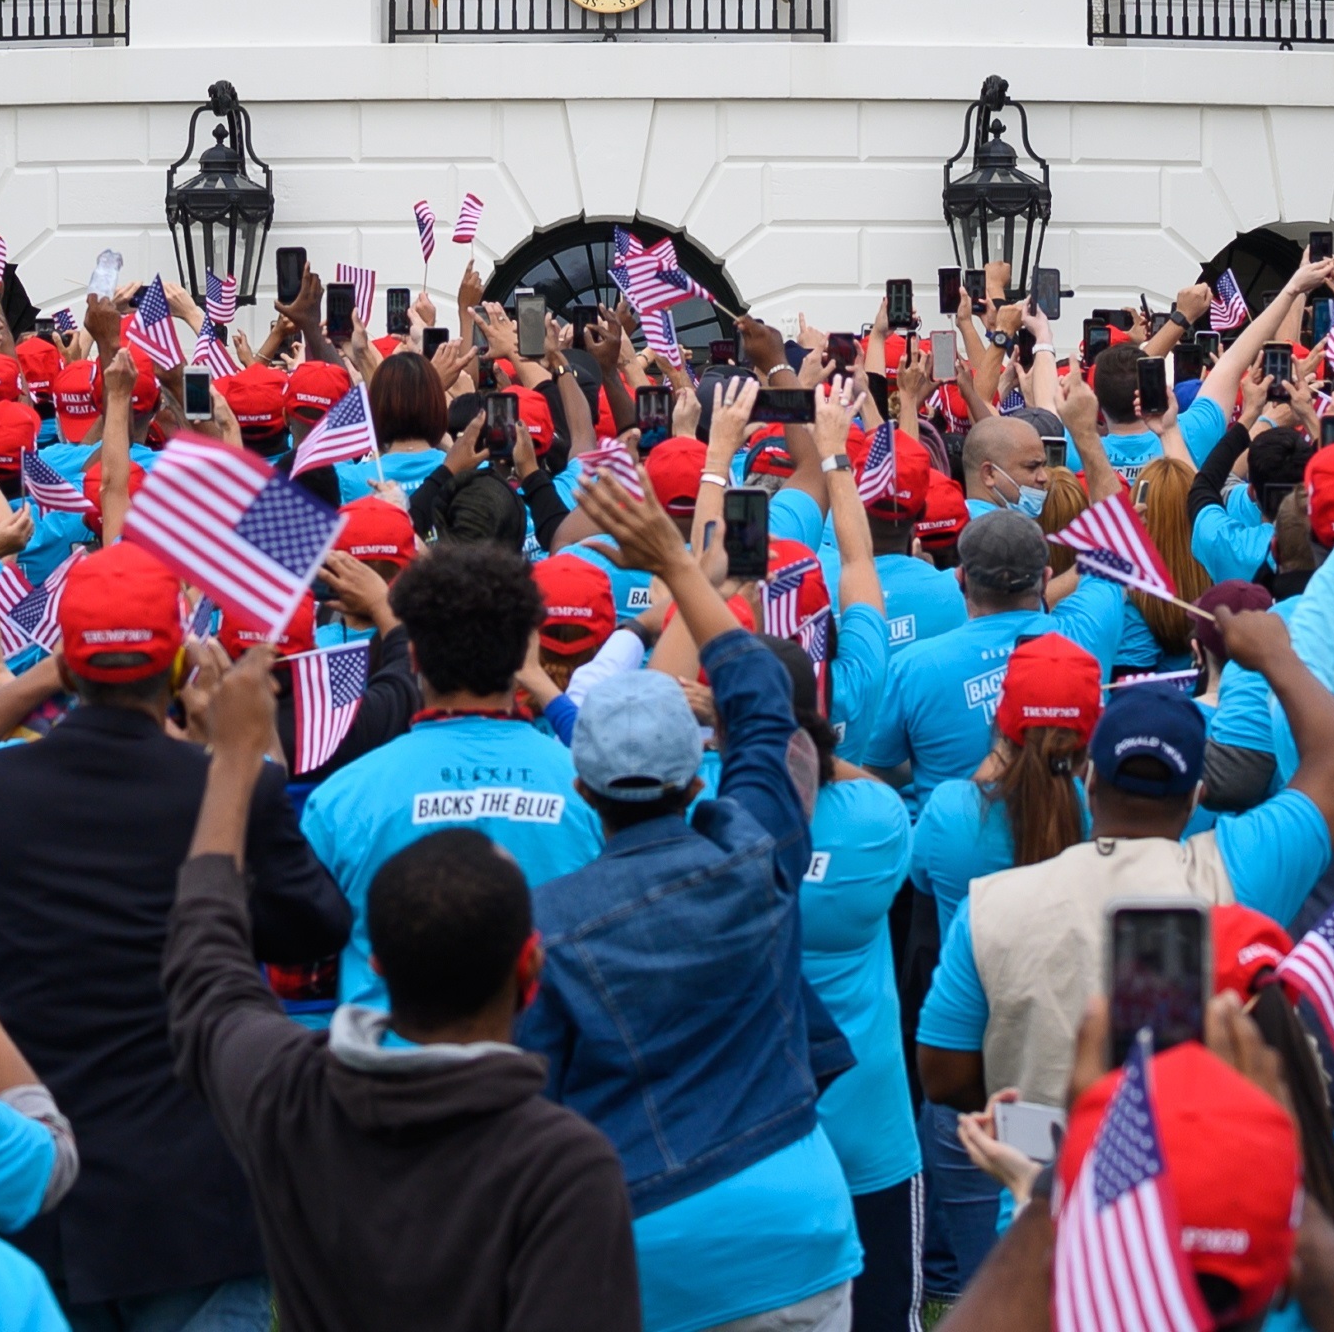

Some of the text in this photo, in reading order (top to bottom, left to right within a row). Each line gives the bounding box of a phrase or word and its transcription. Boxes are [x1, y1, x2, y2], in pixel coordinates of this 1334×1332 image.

[61, 393, 79, 403] MAKE
[296, 392, 331, 405] TRUMP2020
[66, 404, 89, 414] GREAT
[1022, 706, 1080, 718] TRUMP2020
[1114, 736, 1160, 756] DONALD
[417, 792, 560, 819] BACKS THE BLUE
